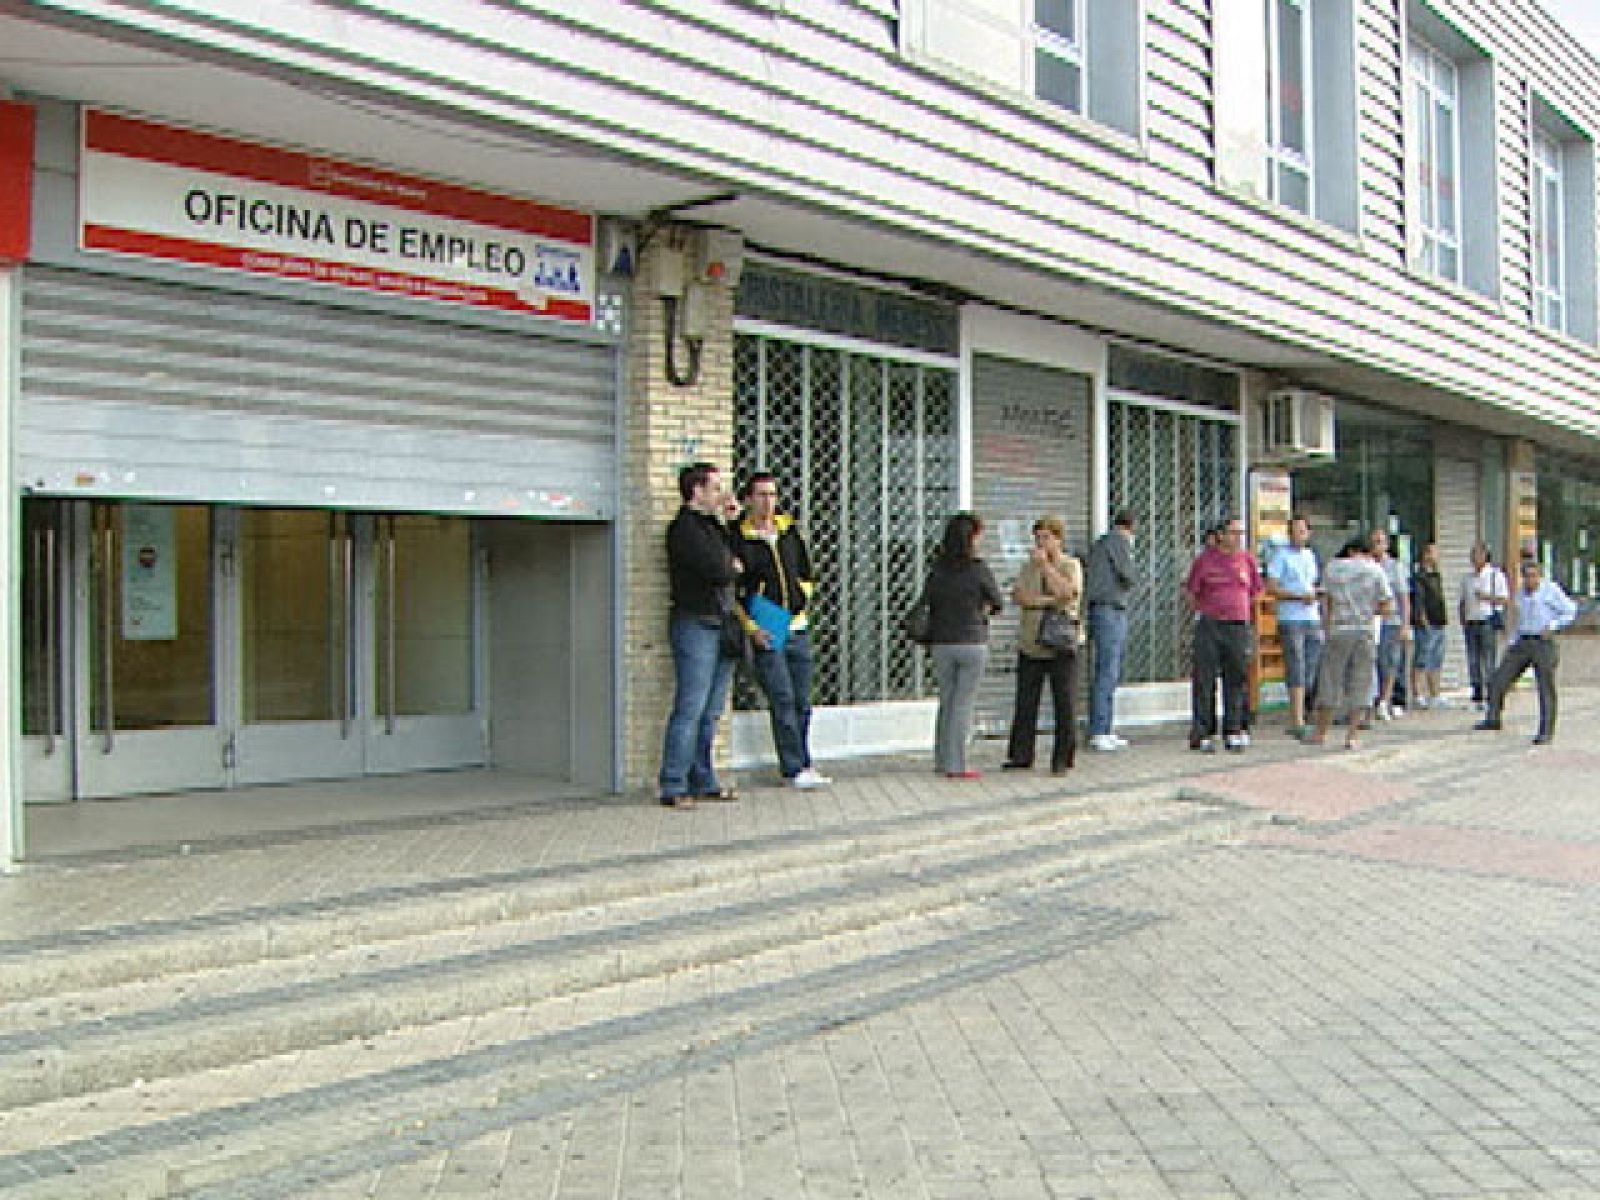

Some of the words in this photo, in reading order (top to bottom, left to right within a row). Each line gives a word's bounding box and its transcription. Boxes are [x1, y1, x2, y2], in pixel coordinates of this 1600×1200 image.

[185, 190, 335, 245] OFICINA
[345, 218, 389, 253] DE
[400, 227, 526, 277] EMPLEO
